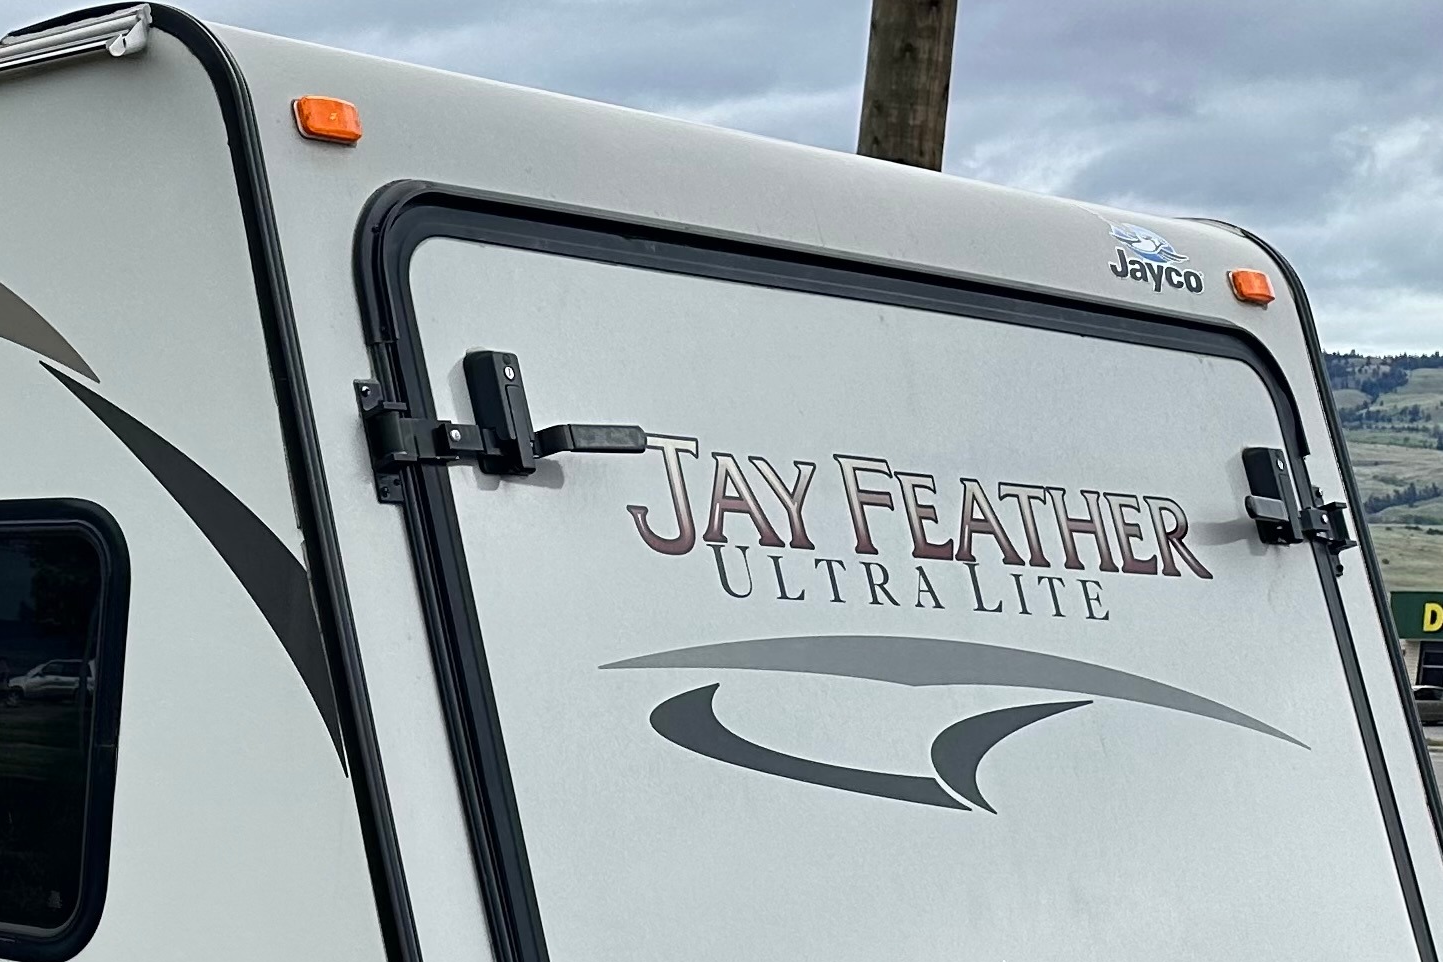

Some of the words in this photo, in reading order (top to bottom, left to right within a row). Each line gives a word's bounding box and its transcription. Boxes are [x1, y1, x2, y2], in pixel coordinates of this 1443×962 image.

[1109, 248, 1204, 294] Jayco
[627, 434, 817, 556] JAY
[833, 453, 1212, 580] FEATHER
[706, 543, 944, 609] ULTRA
[957, 562, 1111, 622] LITE
